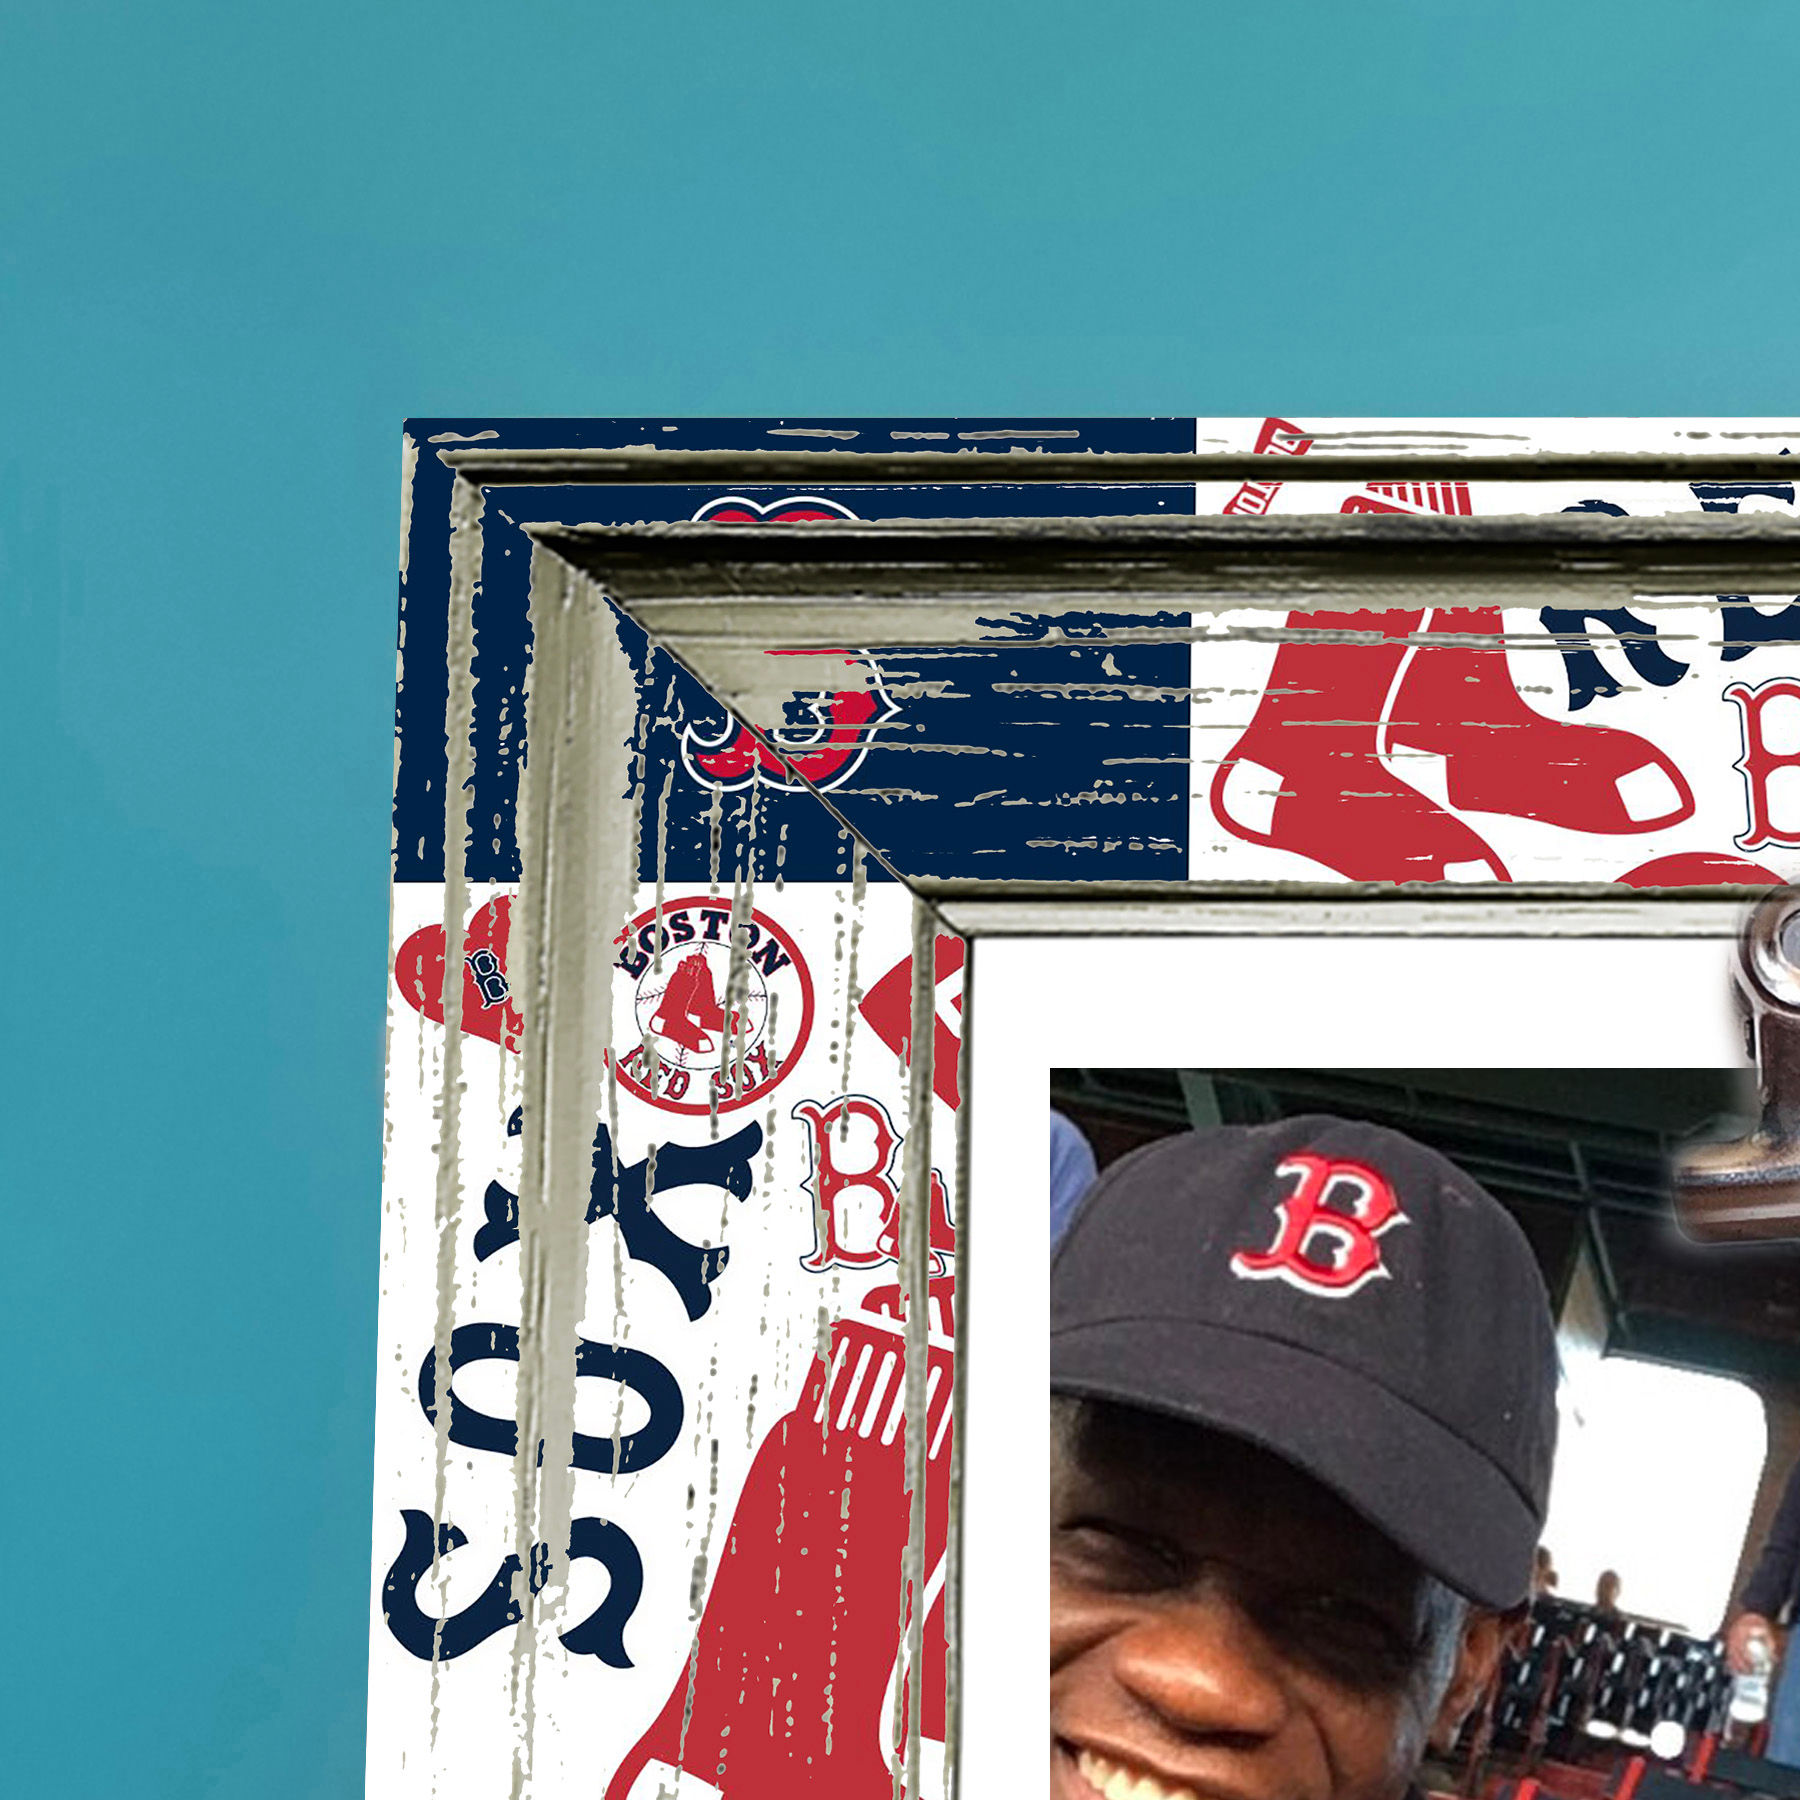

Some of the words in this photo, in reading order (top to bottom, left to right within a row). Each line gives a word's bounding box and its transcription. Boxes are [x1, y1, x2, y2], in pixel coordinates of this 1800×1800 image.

[613, 909, 791, 981] BOSTON
[1229, 1150, 1411, 1298] B
[382, 1105, 763, 1670] SOX
